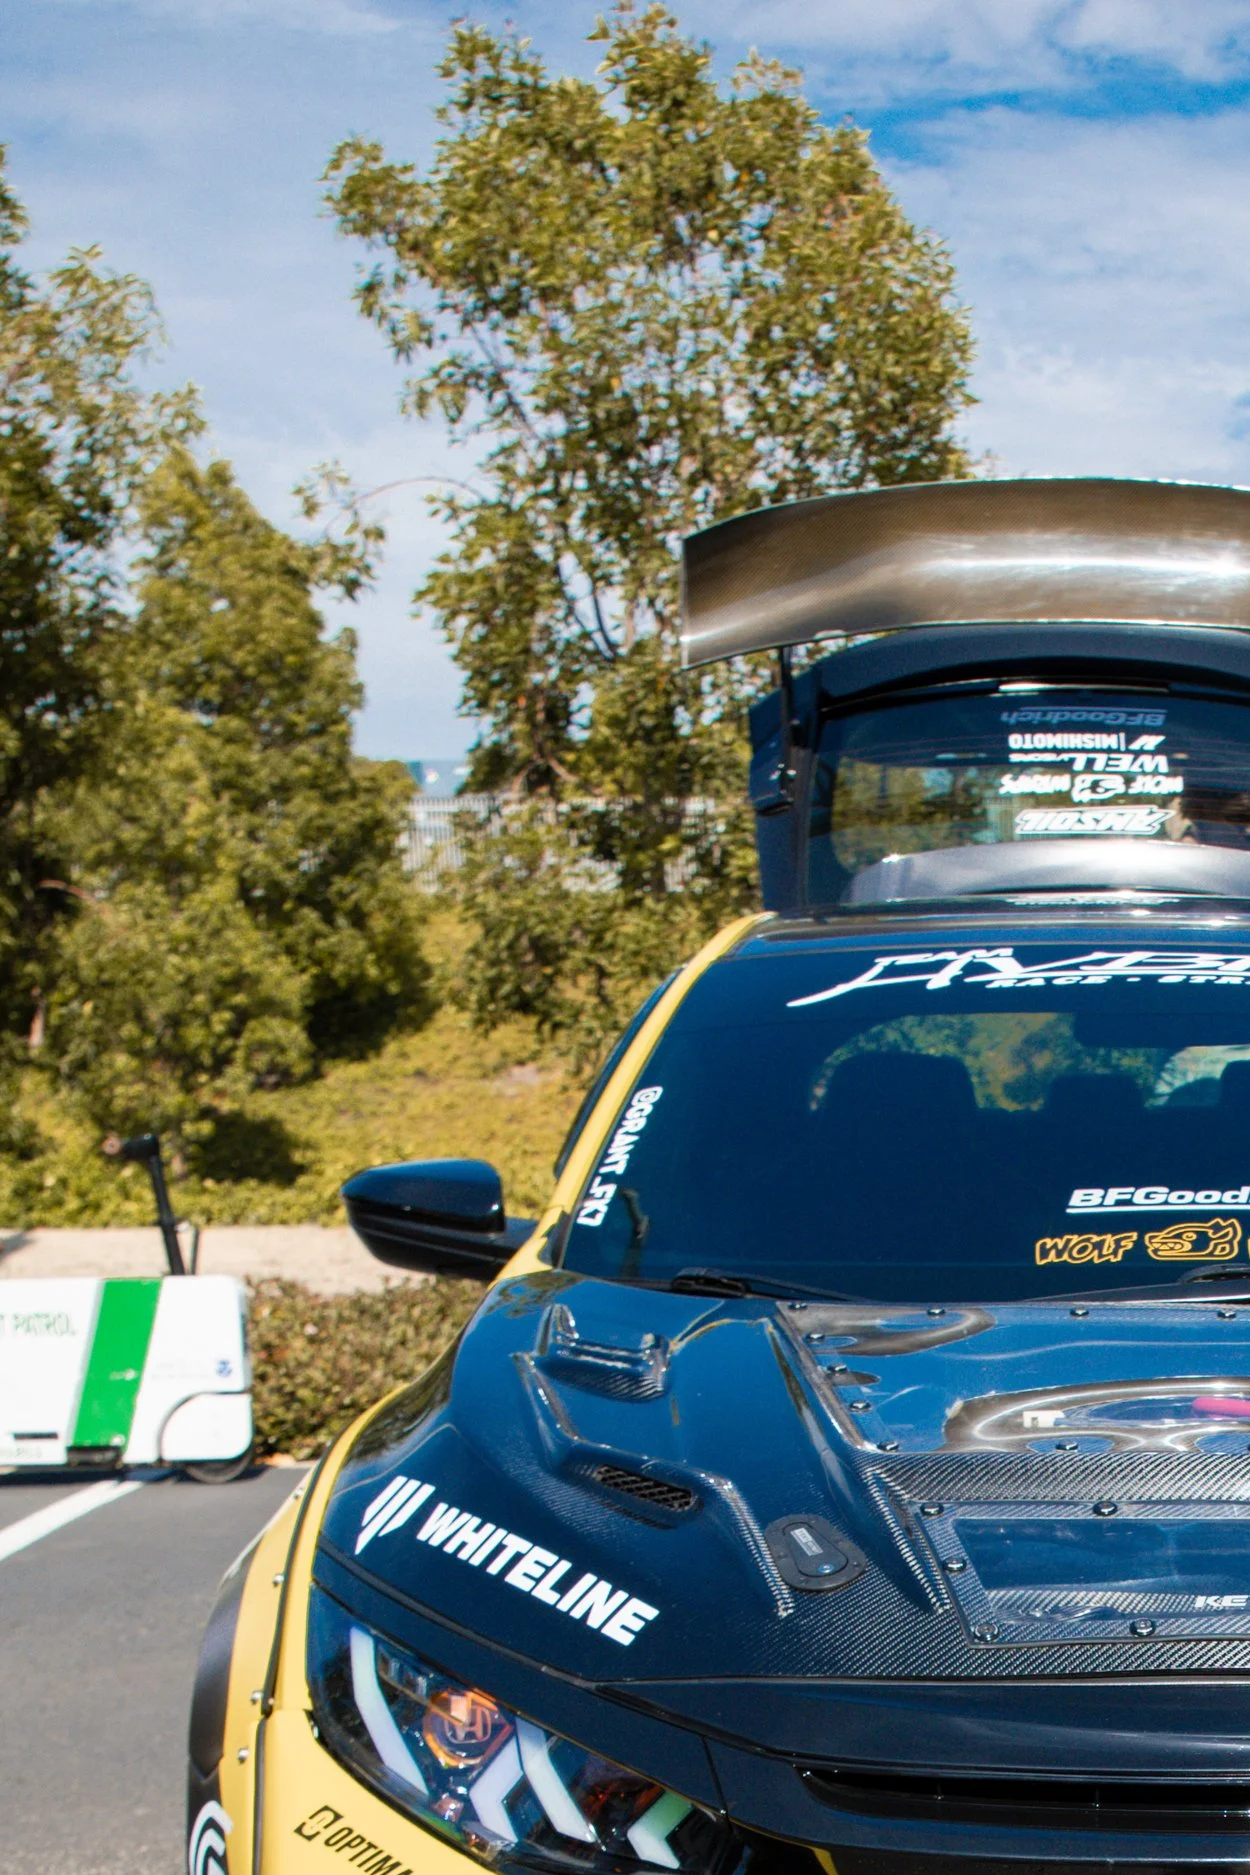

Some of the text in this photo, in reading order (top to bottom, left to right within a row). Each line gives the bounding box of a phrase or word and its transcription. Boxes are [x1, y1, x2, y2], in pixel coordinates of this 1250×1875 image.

[1000, 711, 1167, 727] BFGoodrich
[1008, 733, 1118, 750] MISHIMOTO
[1128, 775, 1184, 794] WOLF
[1018, 807, 1168, 833] AMSOIL
[985, 975, 1112, 989] RACE
[1035, 1231, 1138, 1265] WOLF
[416, 1501, 661, 1647] WHITELINE
